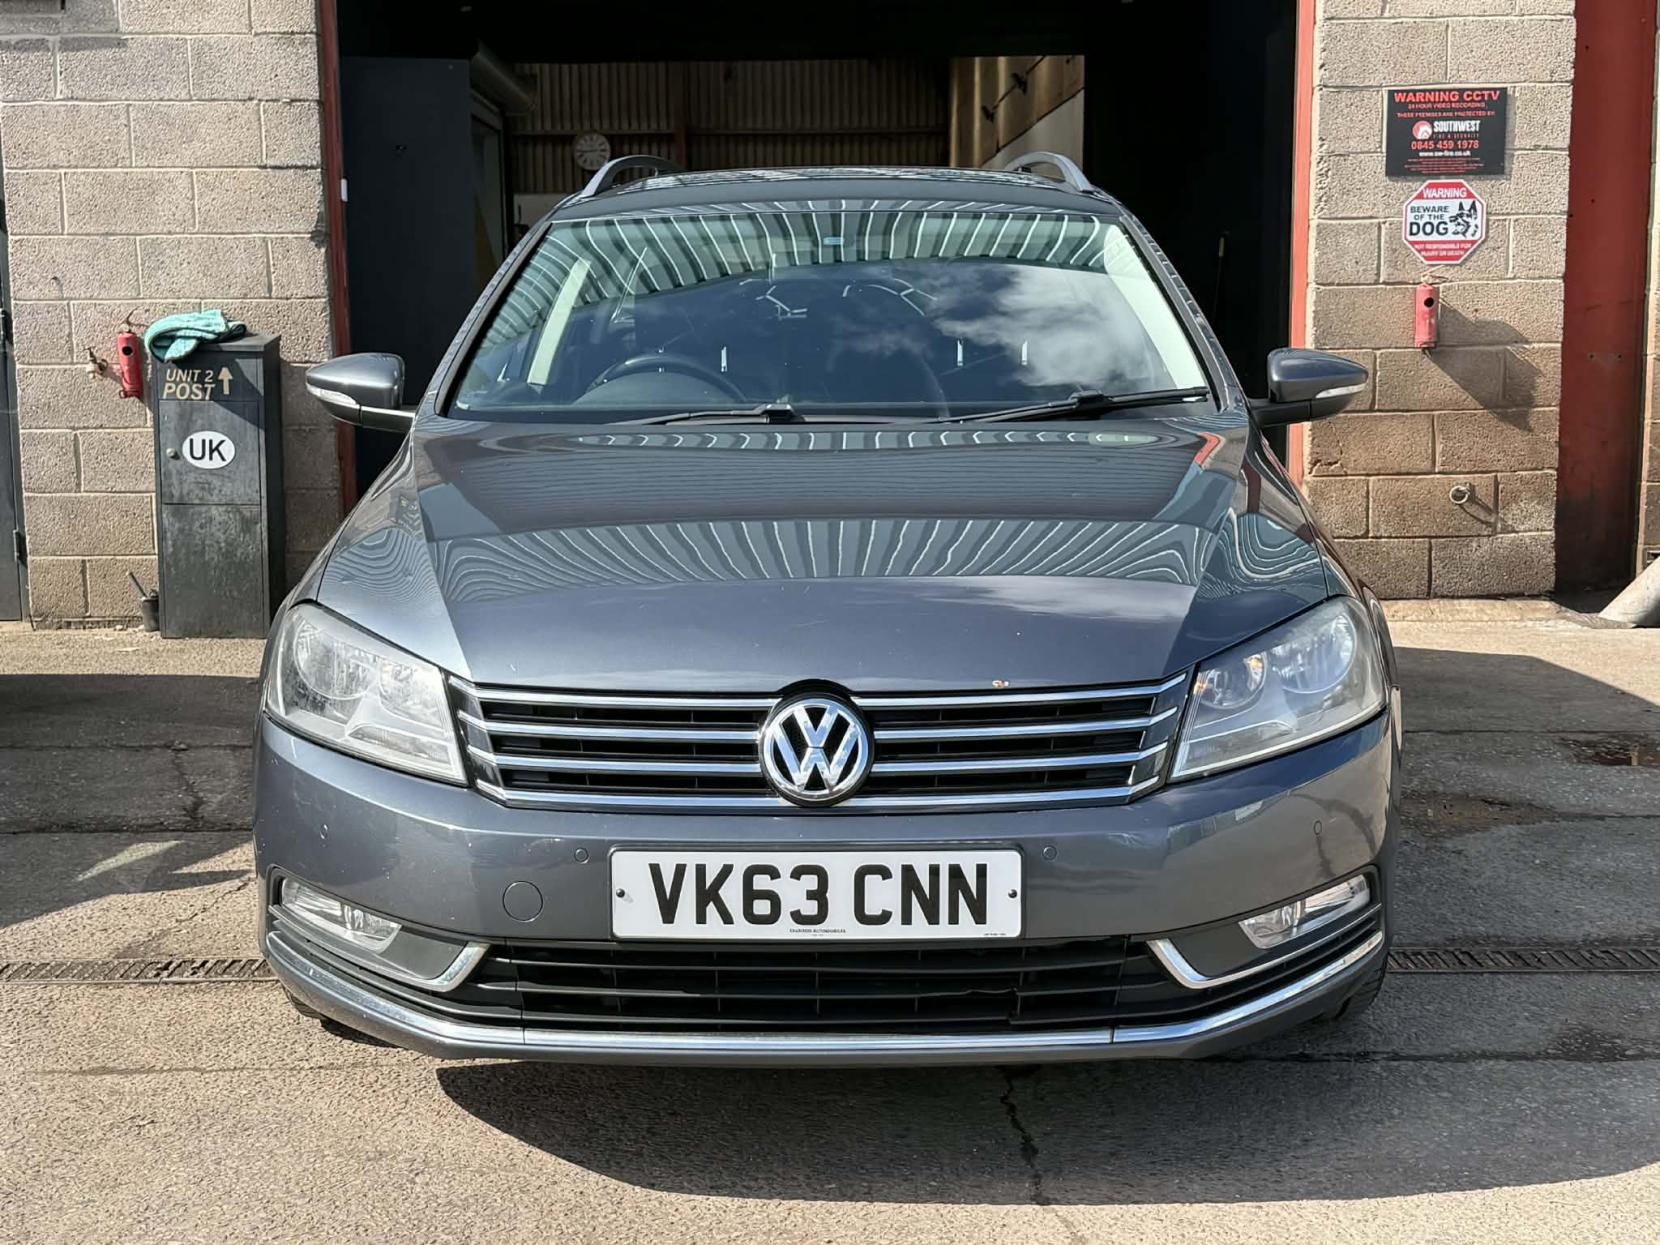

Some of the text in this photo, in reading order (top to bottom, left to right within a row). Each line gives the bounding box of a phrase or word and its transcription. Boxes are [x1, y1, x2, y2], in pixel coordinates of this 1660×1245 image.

[1394, 90, 1500, 102] WARNING CCTV
[1433, 120, 1480, 132] SOUTHWEST
[1411, 140, 1479, 150] 0845 459 1978
[1423, 188, 1467, 198] WARNING
[1409, 221, 1448, 236] DOG
[166, 369, 213, 382] UNIT 2
[163, 383, 215, 400] POST
[189, 438, 226, 461] UK
[649, 863, 988, 926] VK63 CNN
